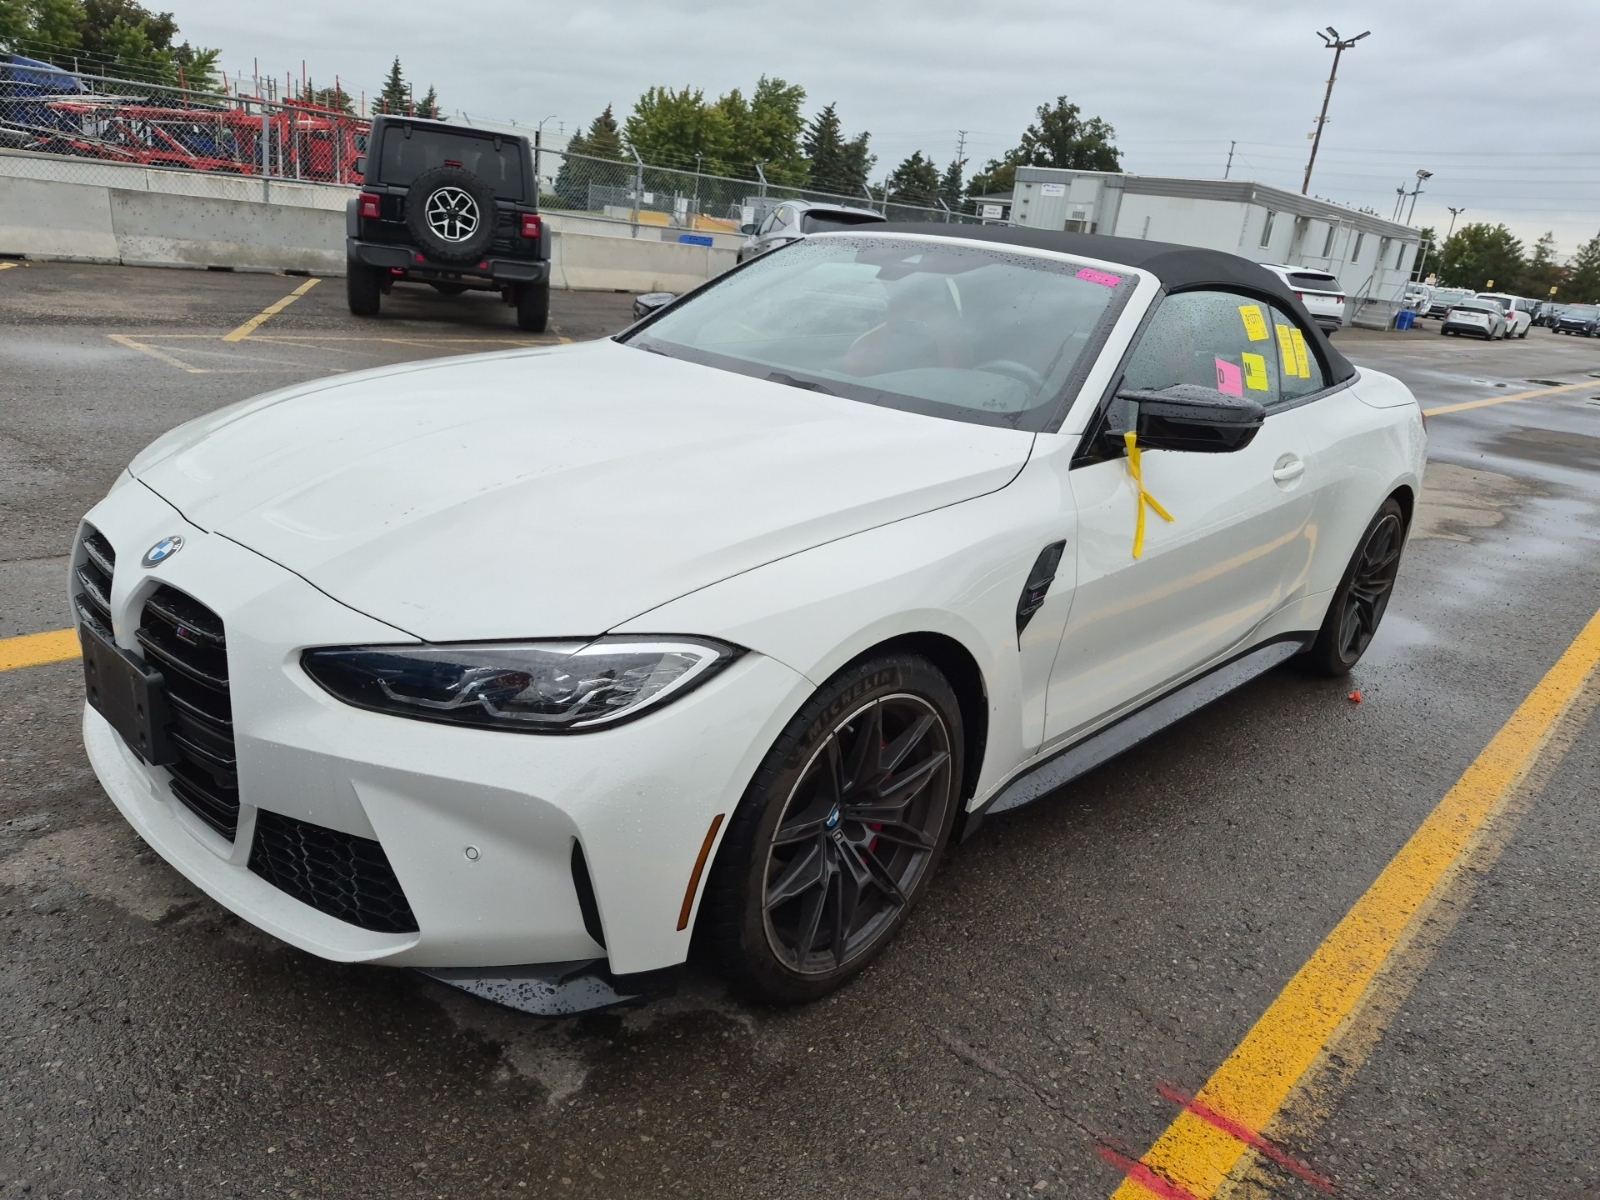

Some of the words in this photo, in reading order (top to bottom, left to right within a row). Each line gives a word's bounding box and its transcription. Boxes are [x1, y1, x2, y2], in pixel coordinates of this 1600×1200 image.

[1218, 368, 1225, 384] D
[1245, 361, 1252, 377] M
[806, 668, 893, 742] MICHELIN
